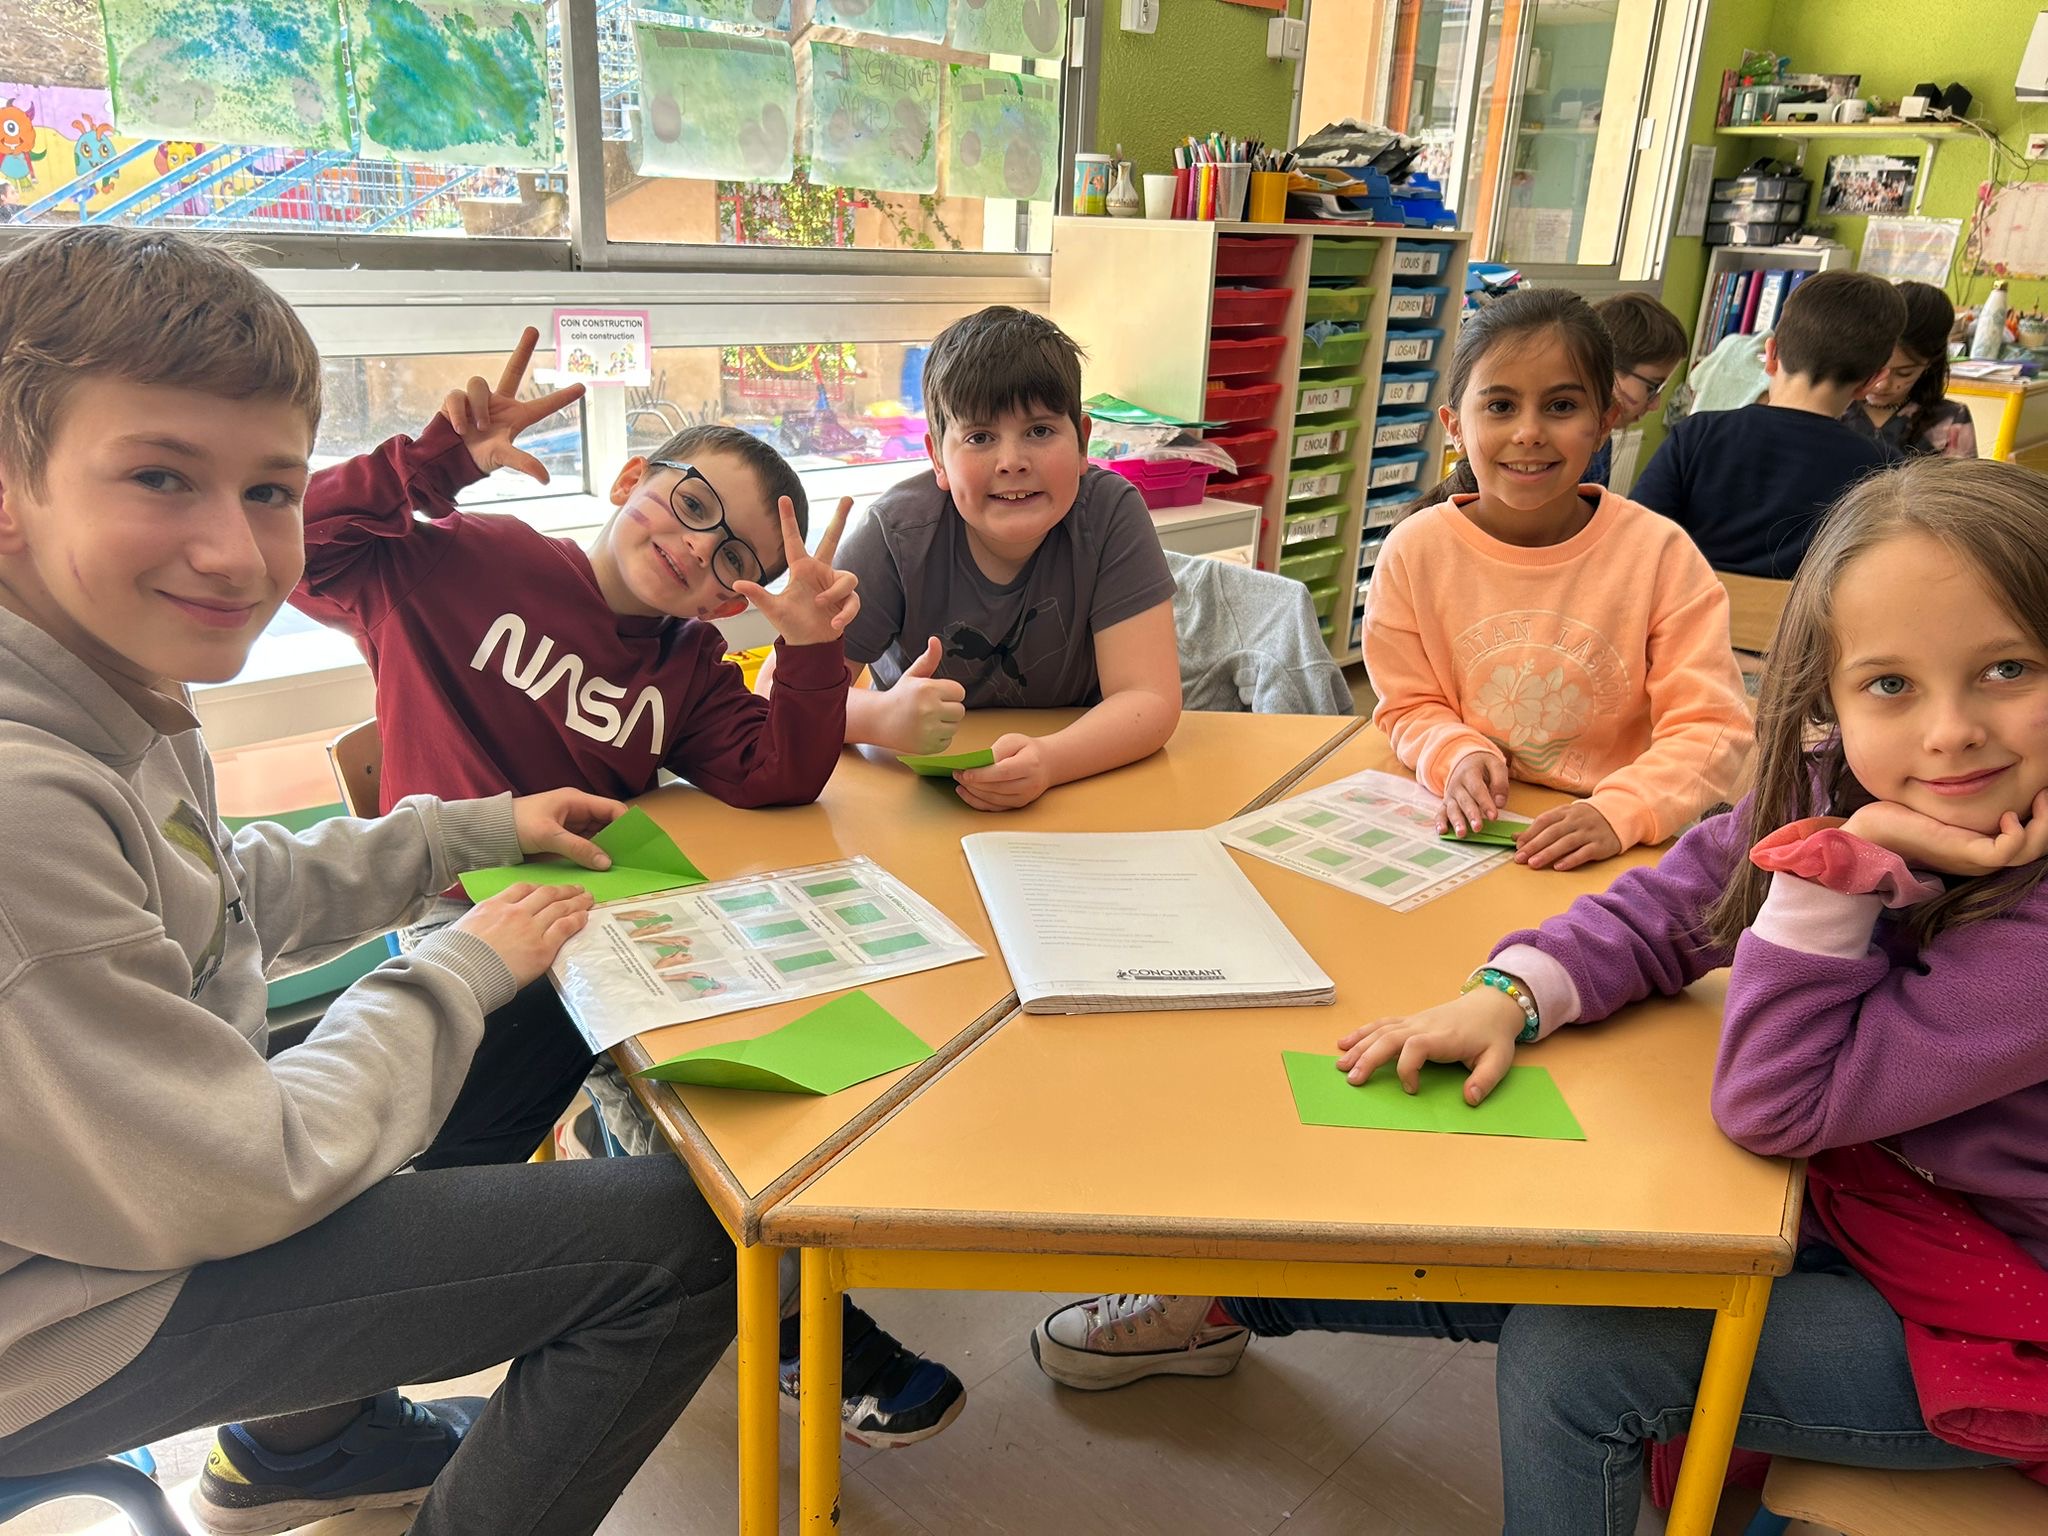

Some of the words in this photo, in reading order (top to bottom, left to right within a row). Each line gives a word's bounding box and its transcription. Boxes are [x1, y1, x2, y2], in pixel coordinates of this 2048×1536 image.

[1401, 257, 1420, 269] LOUIS
[1396, 300, 1421, 312] ADRIEN
[560, 319, 581, 327] COIN
[582, 319, 643, 328] CONSTRUCTION
[571, 332, 588, 340] coin
[589, 332, 635, 340] construction
[1394, 345, 1417, 356] LOGAN
[1390, 387, 1403, 399] LEO
[1307, 393, 1328, 406] MYLO
[1303, 438, 1328, 451] ENOLA
[1298, 481, 1315, 493] LYSE
[1291, 524, 1315, 536] ADAM
[470, 612, 665, 755] NASA
[1128, 967, 1223, 977] CONQUERANT
